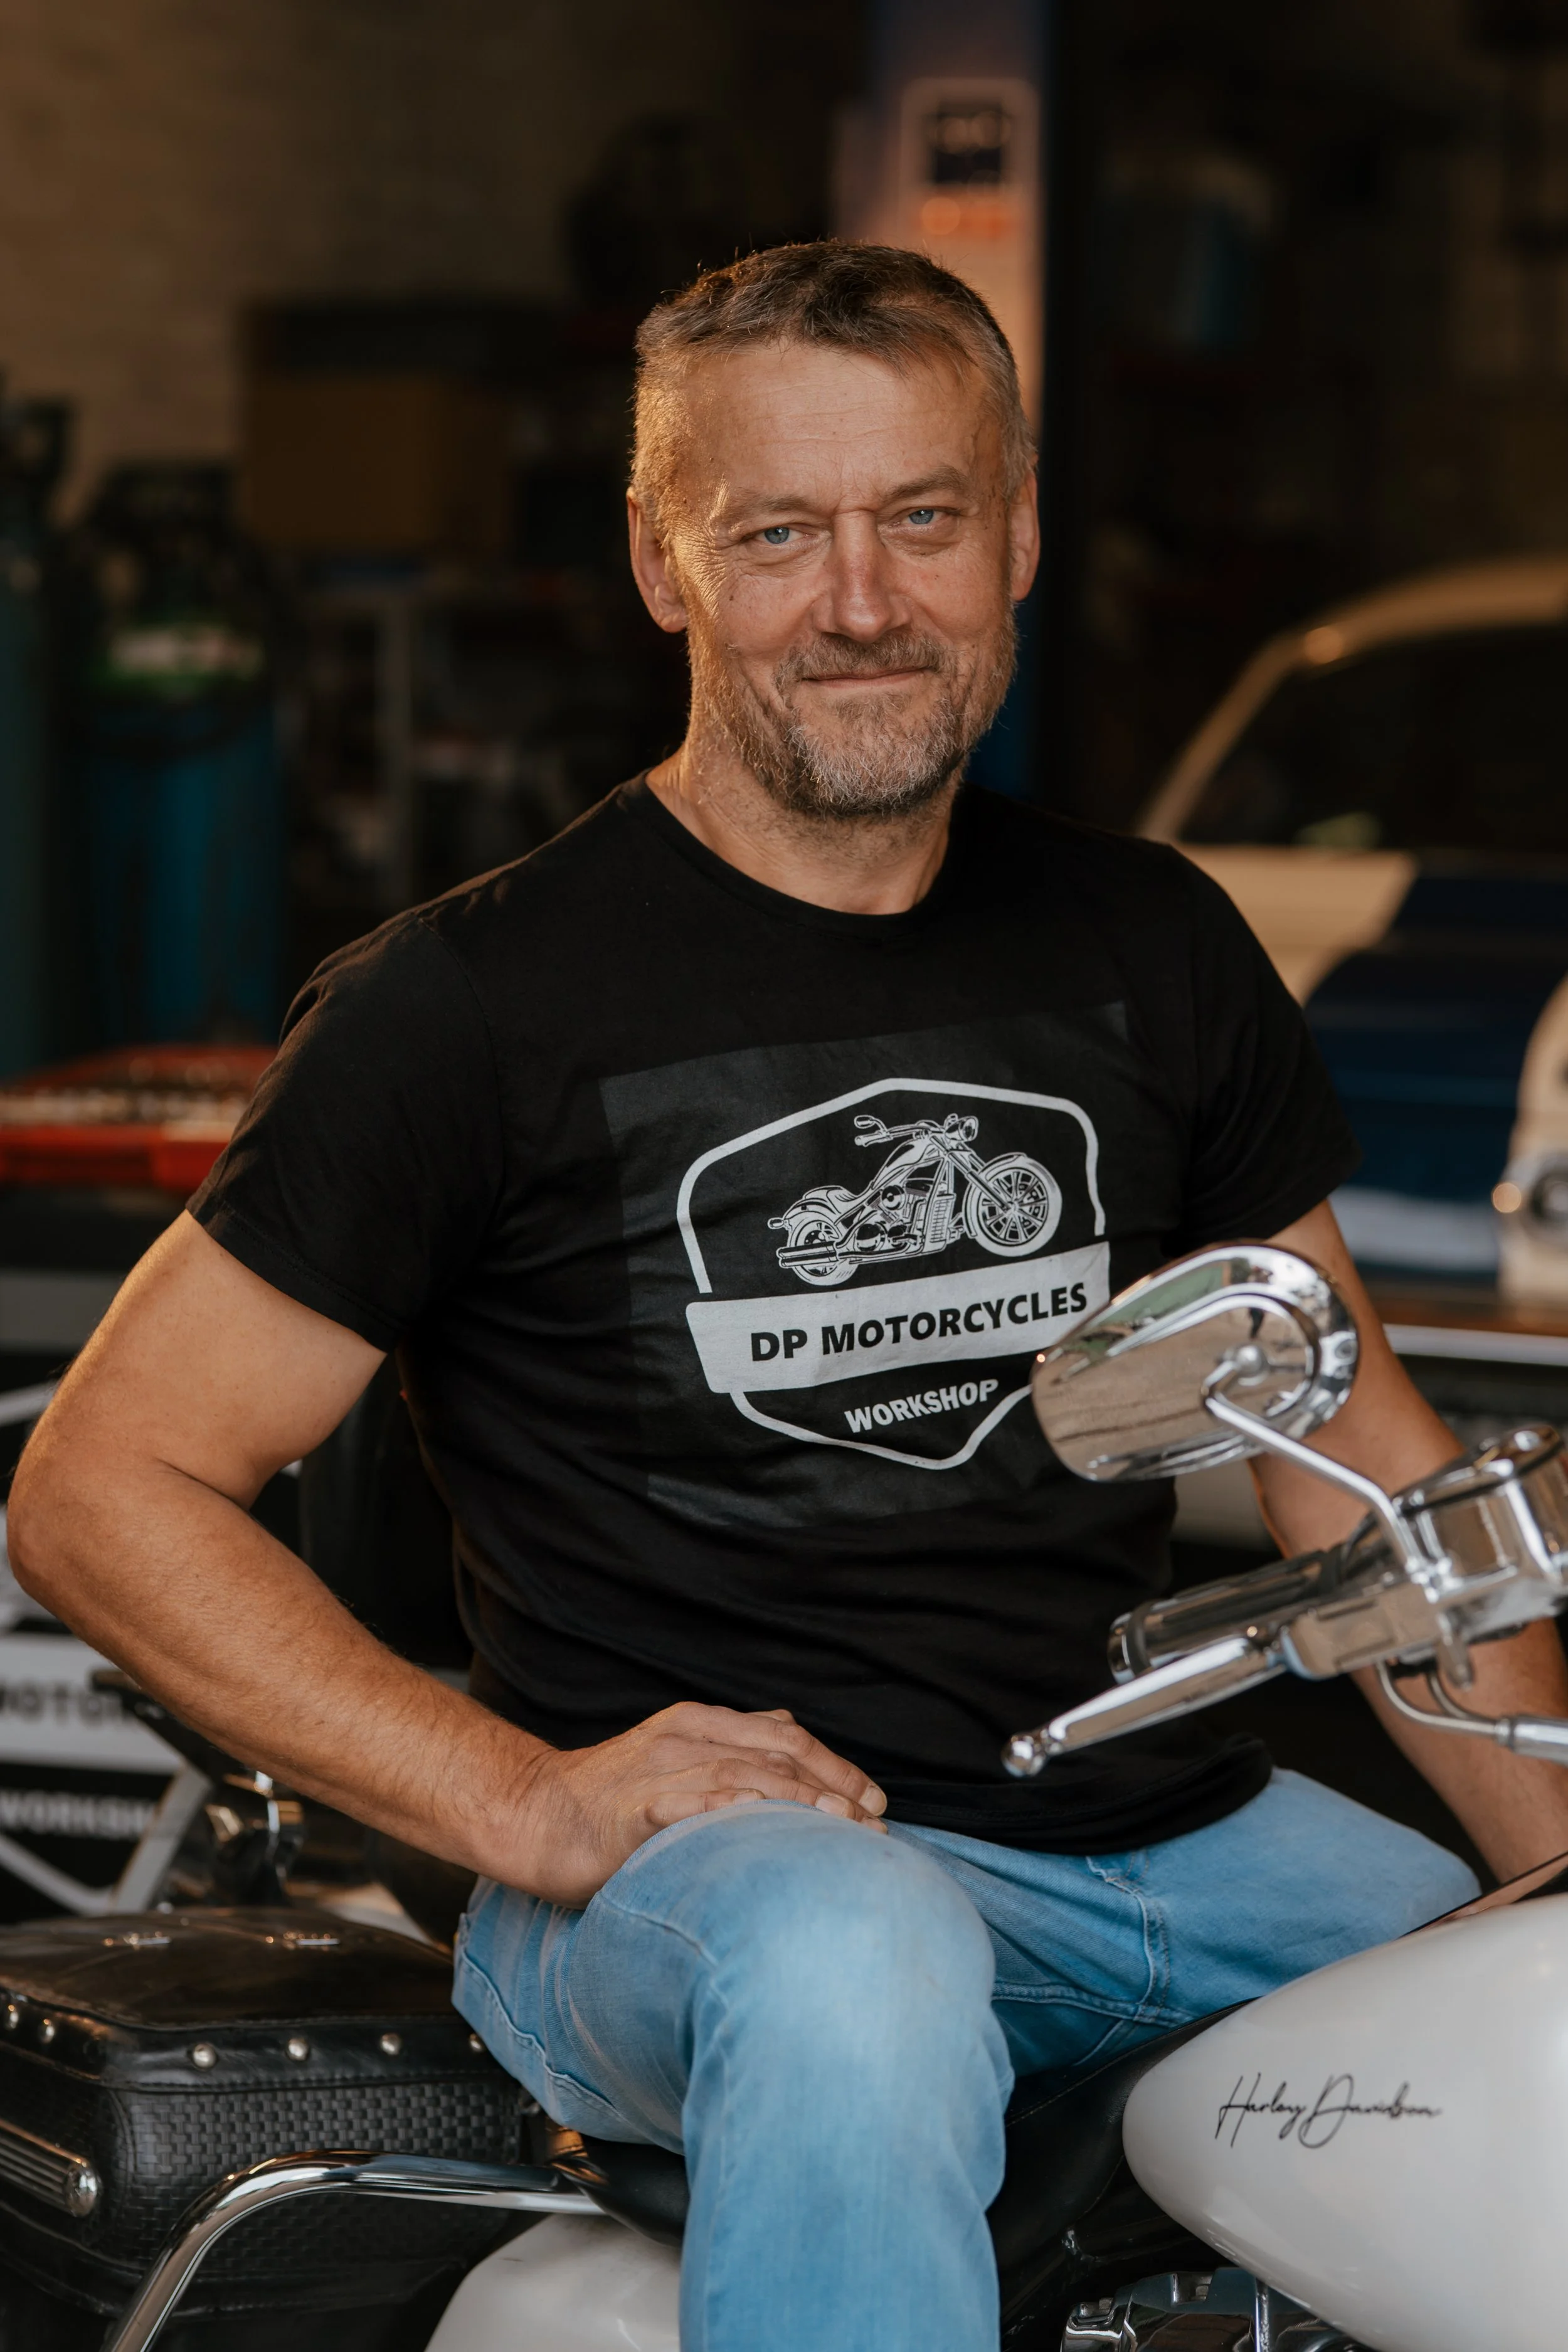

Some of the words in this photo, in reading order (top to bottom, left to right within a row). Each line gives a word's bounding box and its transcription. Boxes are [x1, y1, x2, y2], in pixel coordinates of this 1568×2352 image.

[751, 1329, 808, 1362] DP
[821, 1282, 1087, 1355] MOTORCYCLES
[844, 1379, 999, 1433] WORKSHOP
[1214, 2072, 1308, 2149] Harley
[1297, 2073, 1443, 2150] Davidson
